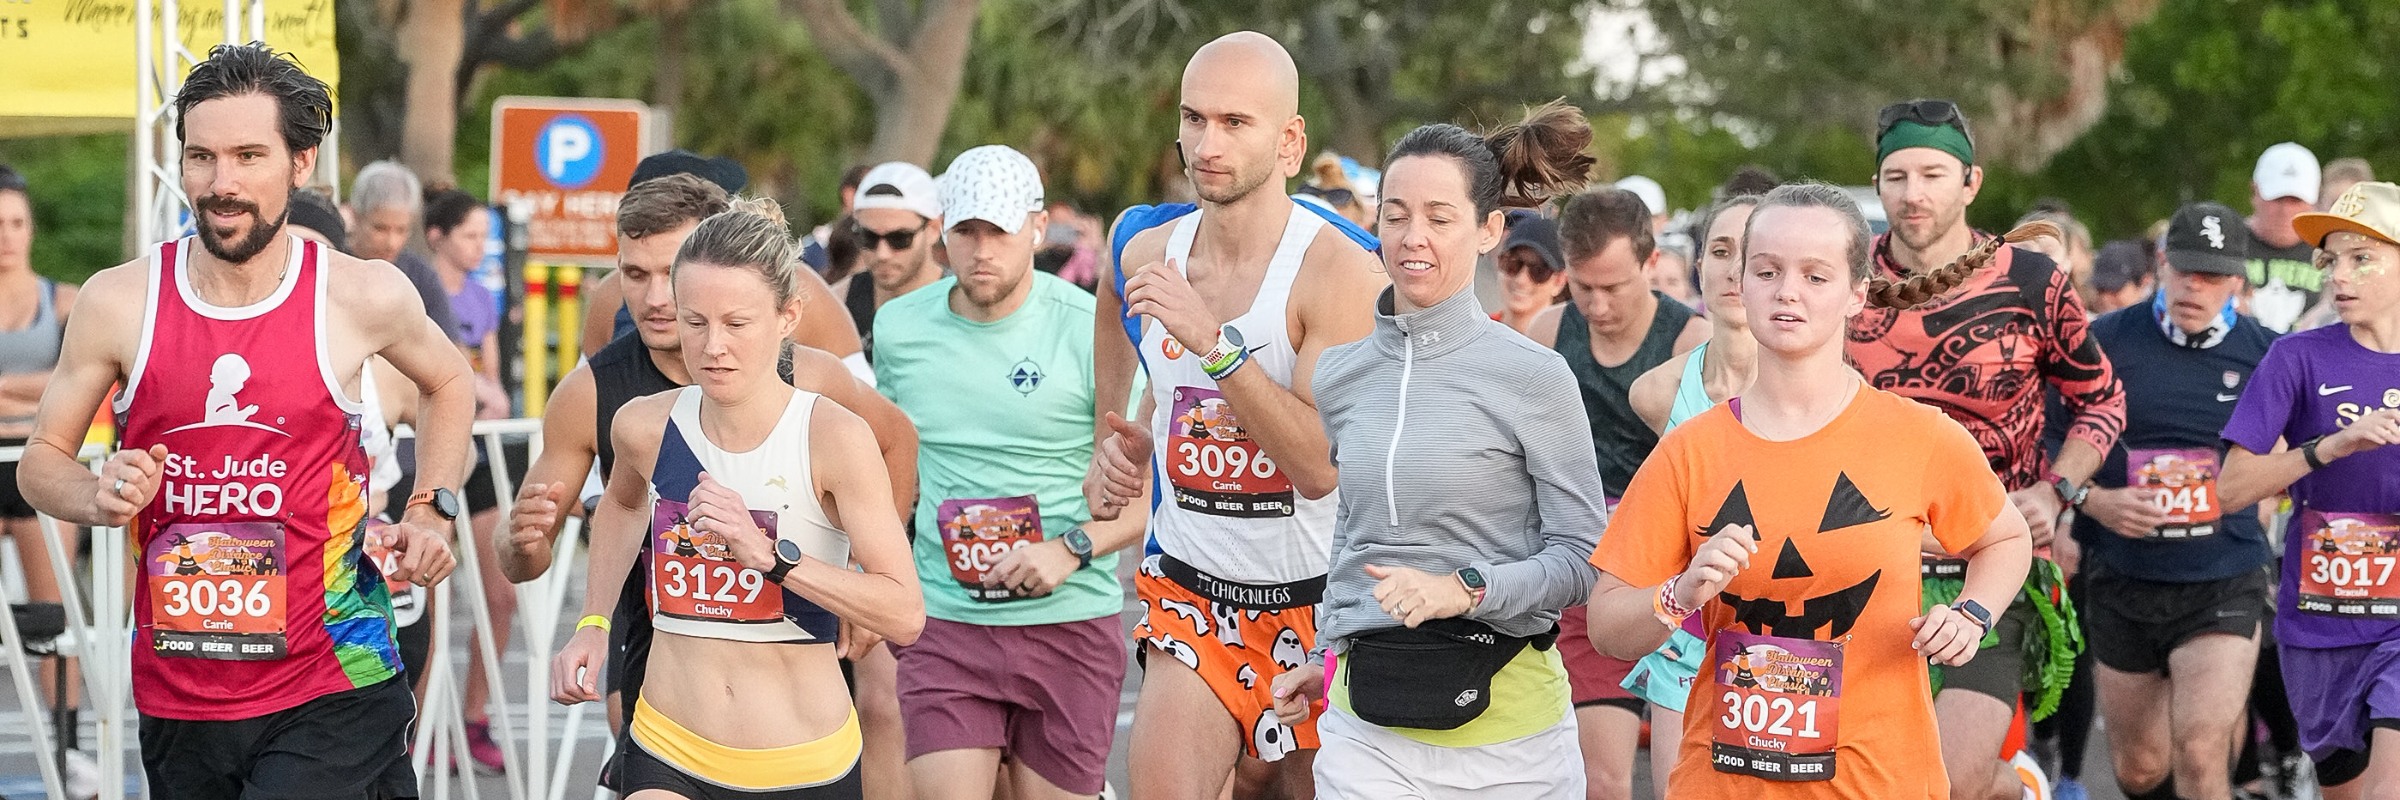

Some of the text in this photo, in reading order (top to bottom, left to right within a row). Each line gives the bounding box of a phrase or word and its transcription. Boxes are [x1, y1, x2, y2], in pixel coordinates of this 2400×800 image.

[548, 124, 592, 178] P
[164, 453, 287, 480] St. Jude
[1178, 442, 1277, 479] 3096
[165, 481, 283, 517] HERO
[1212, 481, 1242, 491] Carrie
[2155, 486, 2210, 513] 041
[1183, 494, 1283, 511] FOOD BEER BEER
[664, 560, 764, 604] 3129
[2310, 554, 2397, 587] 3017
[163, 579, 271, 617] 3036
[1211, 580, 1291, 605] CHICKNLEGS
[694, 603, 733, 617] Chucky
[202, 619, 234, 630] Carrie
[162, 640, 274, 653] FOOD BEER BEER
[1721, 691, 1821, 739] 3021
[1748, 735, 1787, 751] Chucky
[1718, 754, 1823, 774] FOOD BEER BEER
